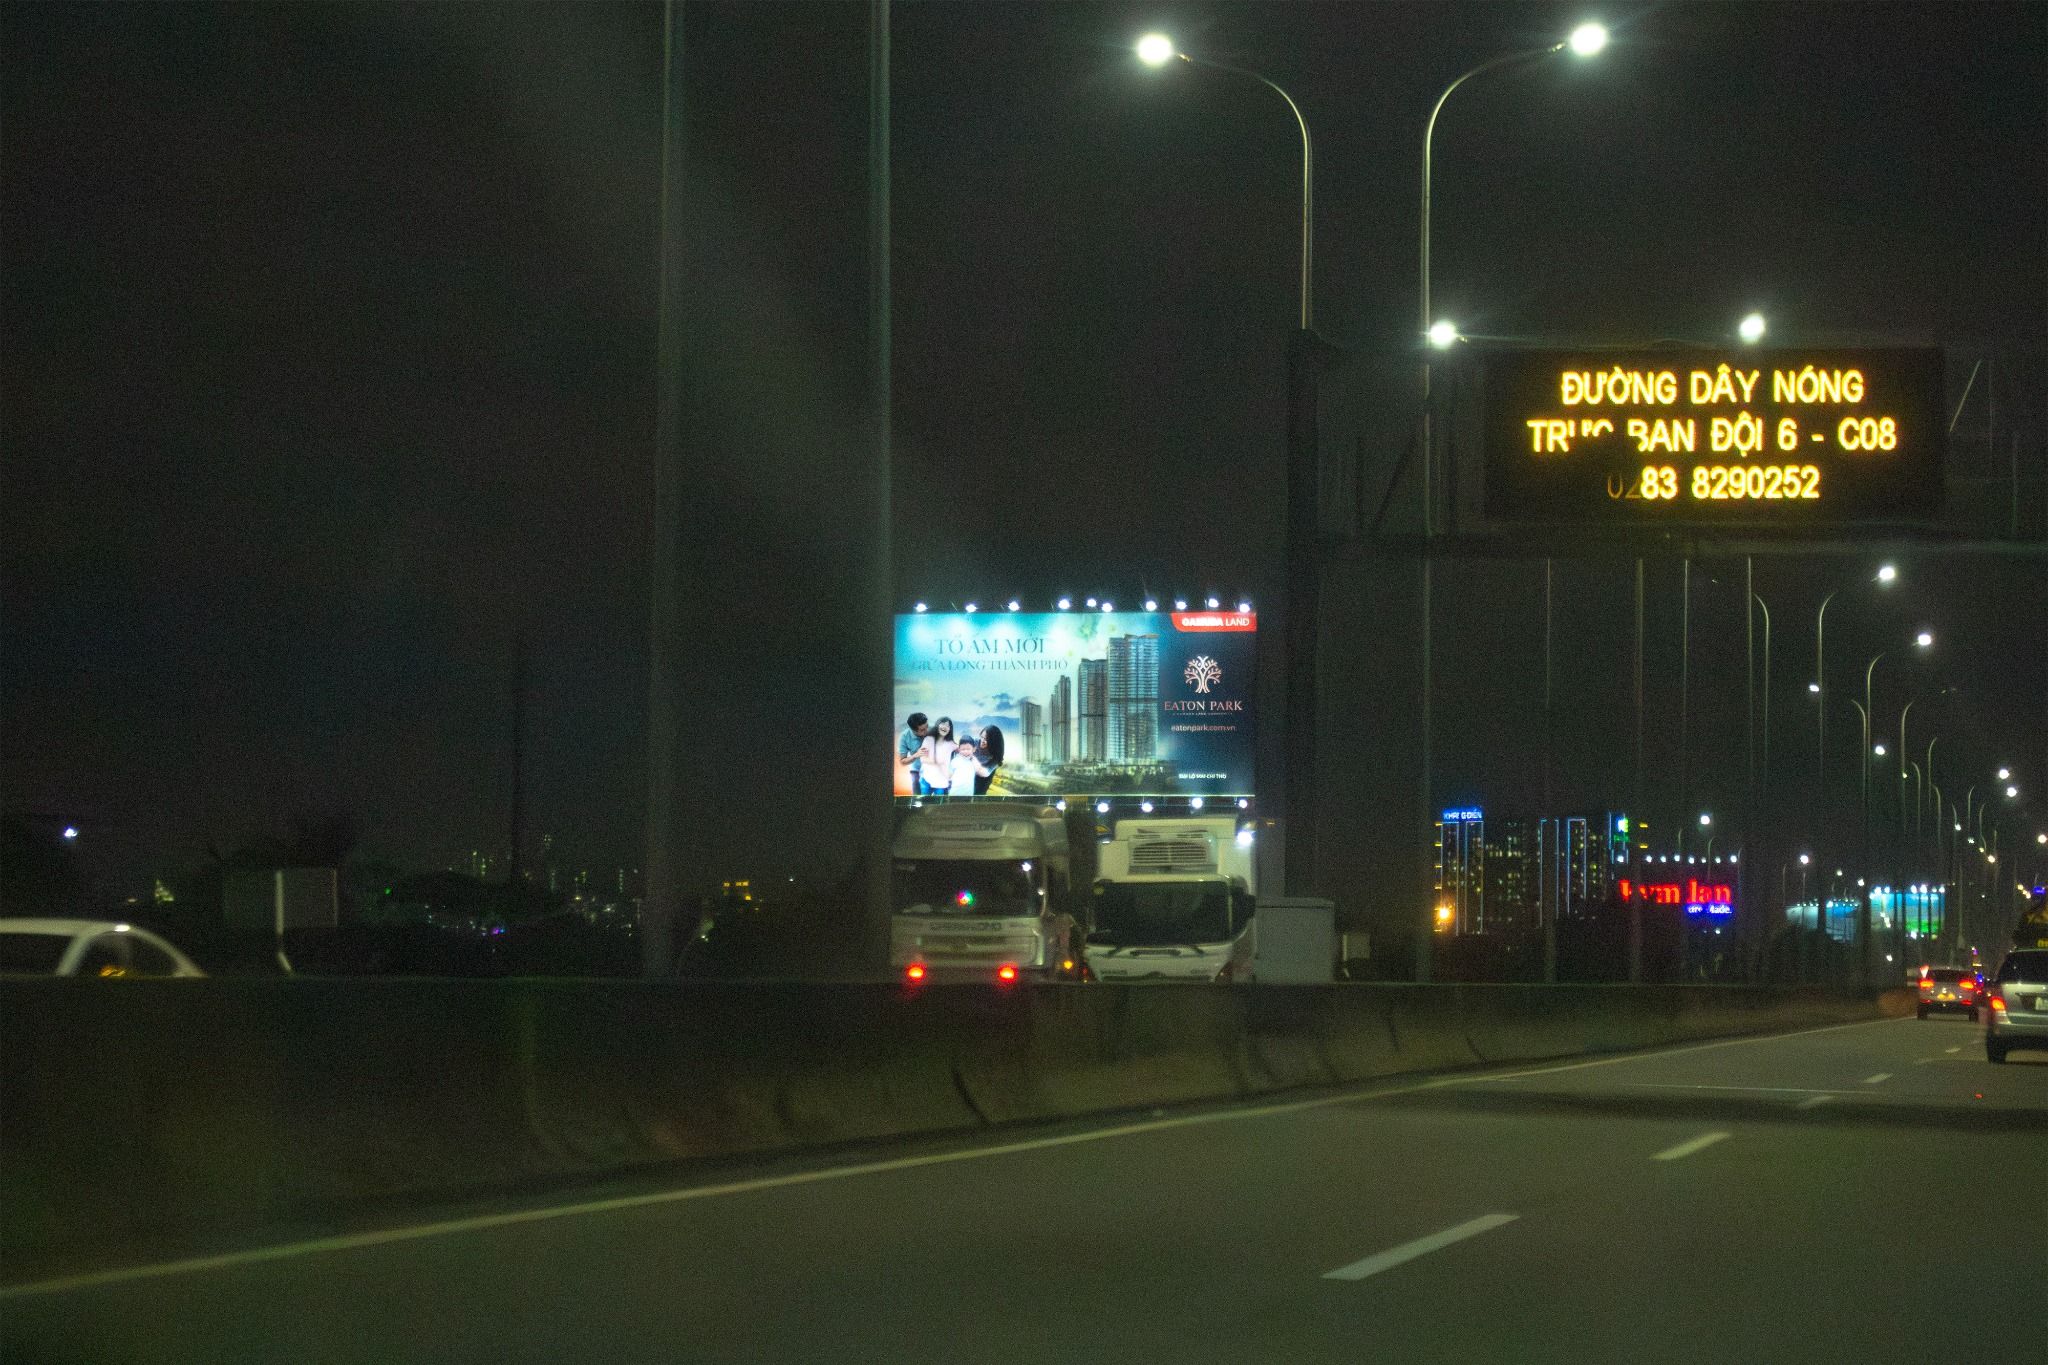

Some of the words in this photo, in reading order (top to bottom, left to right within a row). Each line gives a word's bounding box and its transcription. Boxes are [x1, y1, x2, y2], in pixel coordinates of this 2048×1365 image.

[1561, 366, 1677, 405] ĐƯỜNG
[1690, 363, 1760, 404] DÂY
[1773, 365, 1864, 403] NÓNG
[1710, 410, 1763, 457] ĐỘI
[1777, 417, 1798, 451] 6
[1811, 433, 1824, 442] -
[1838, 416, 1896, 451] C08
[1692, 465, 1820, 499] 8290252
[1225, 618, 1250, 627] LAND
[1164, 700, 1206, 711] EATON
[1210, 700, 1243, 711] PARK
[1171, 724, 1237, 733] eatonpark.com.vn
